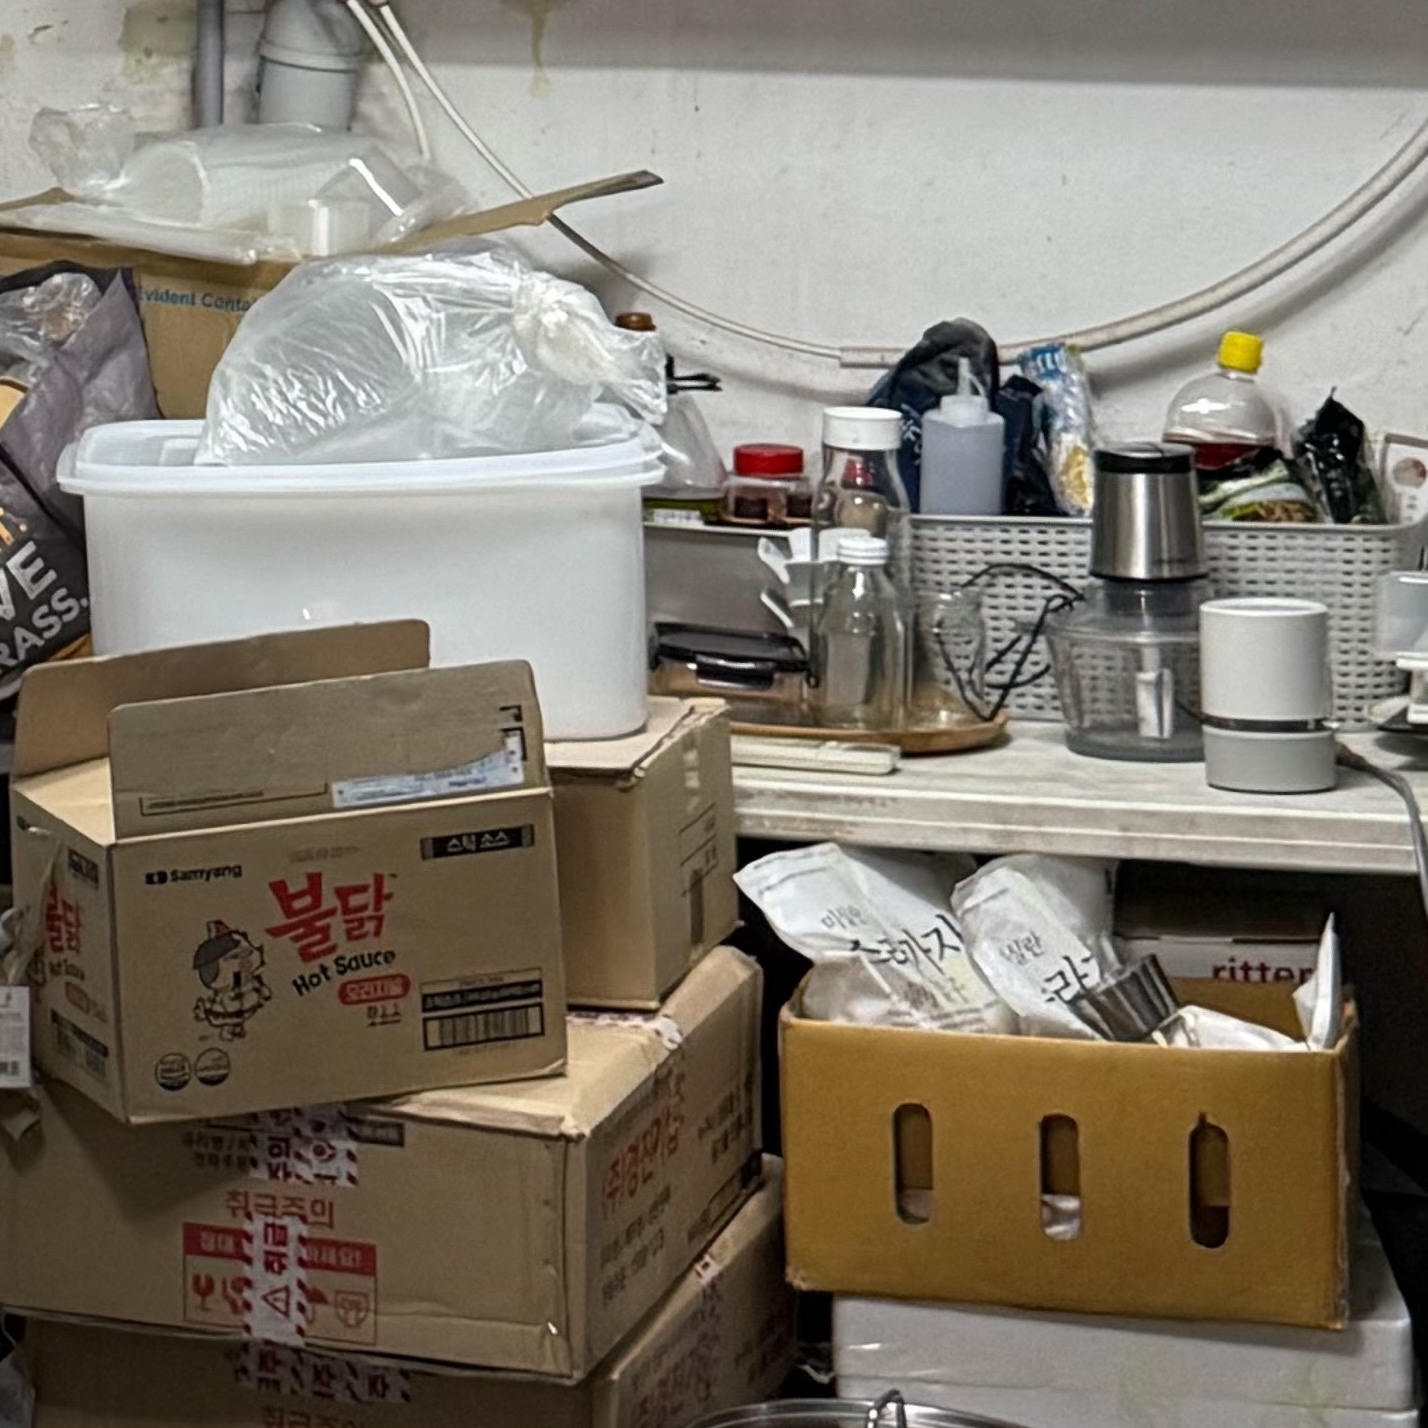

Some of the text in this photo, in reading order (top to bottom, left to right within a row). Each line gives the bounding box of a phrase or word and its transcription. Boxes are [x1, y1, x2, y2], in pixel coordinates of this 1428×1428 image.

[201, 292, 258, 314] Conta
[264, 871, 394, 964] 불닭
[292, 948, 397, 998] Hot Sauce
